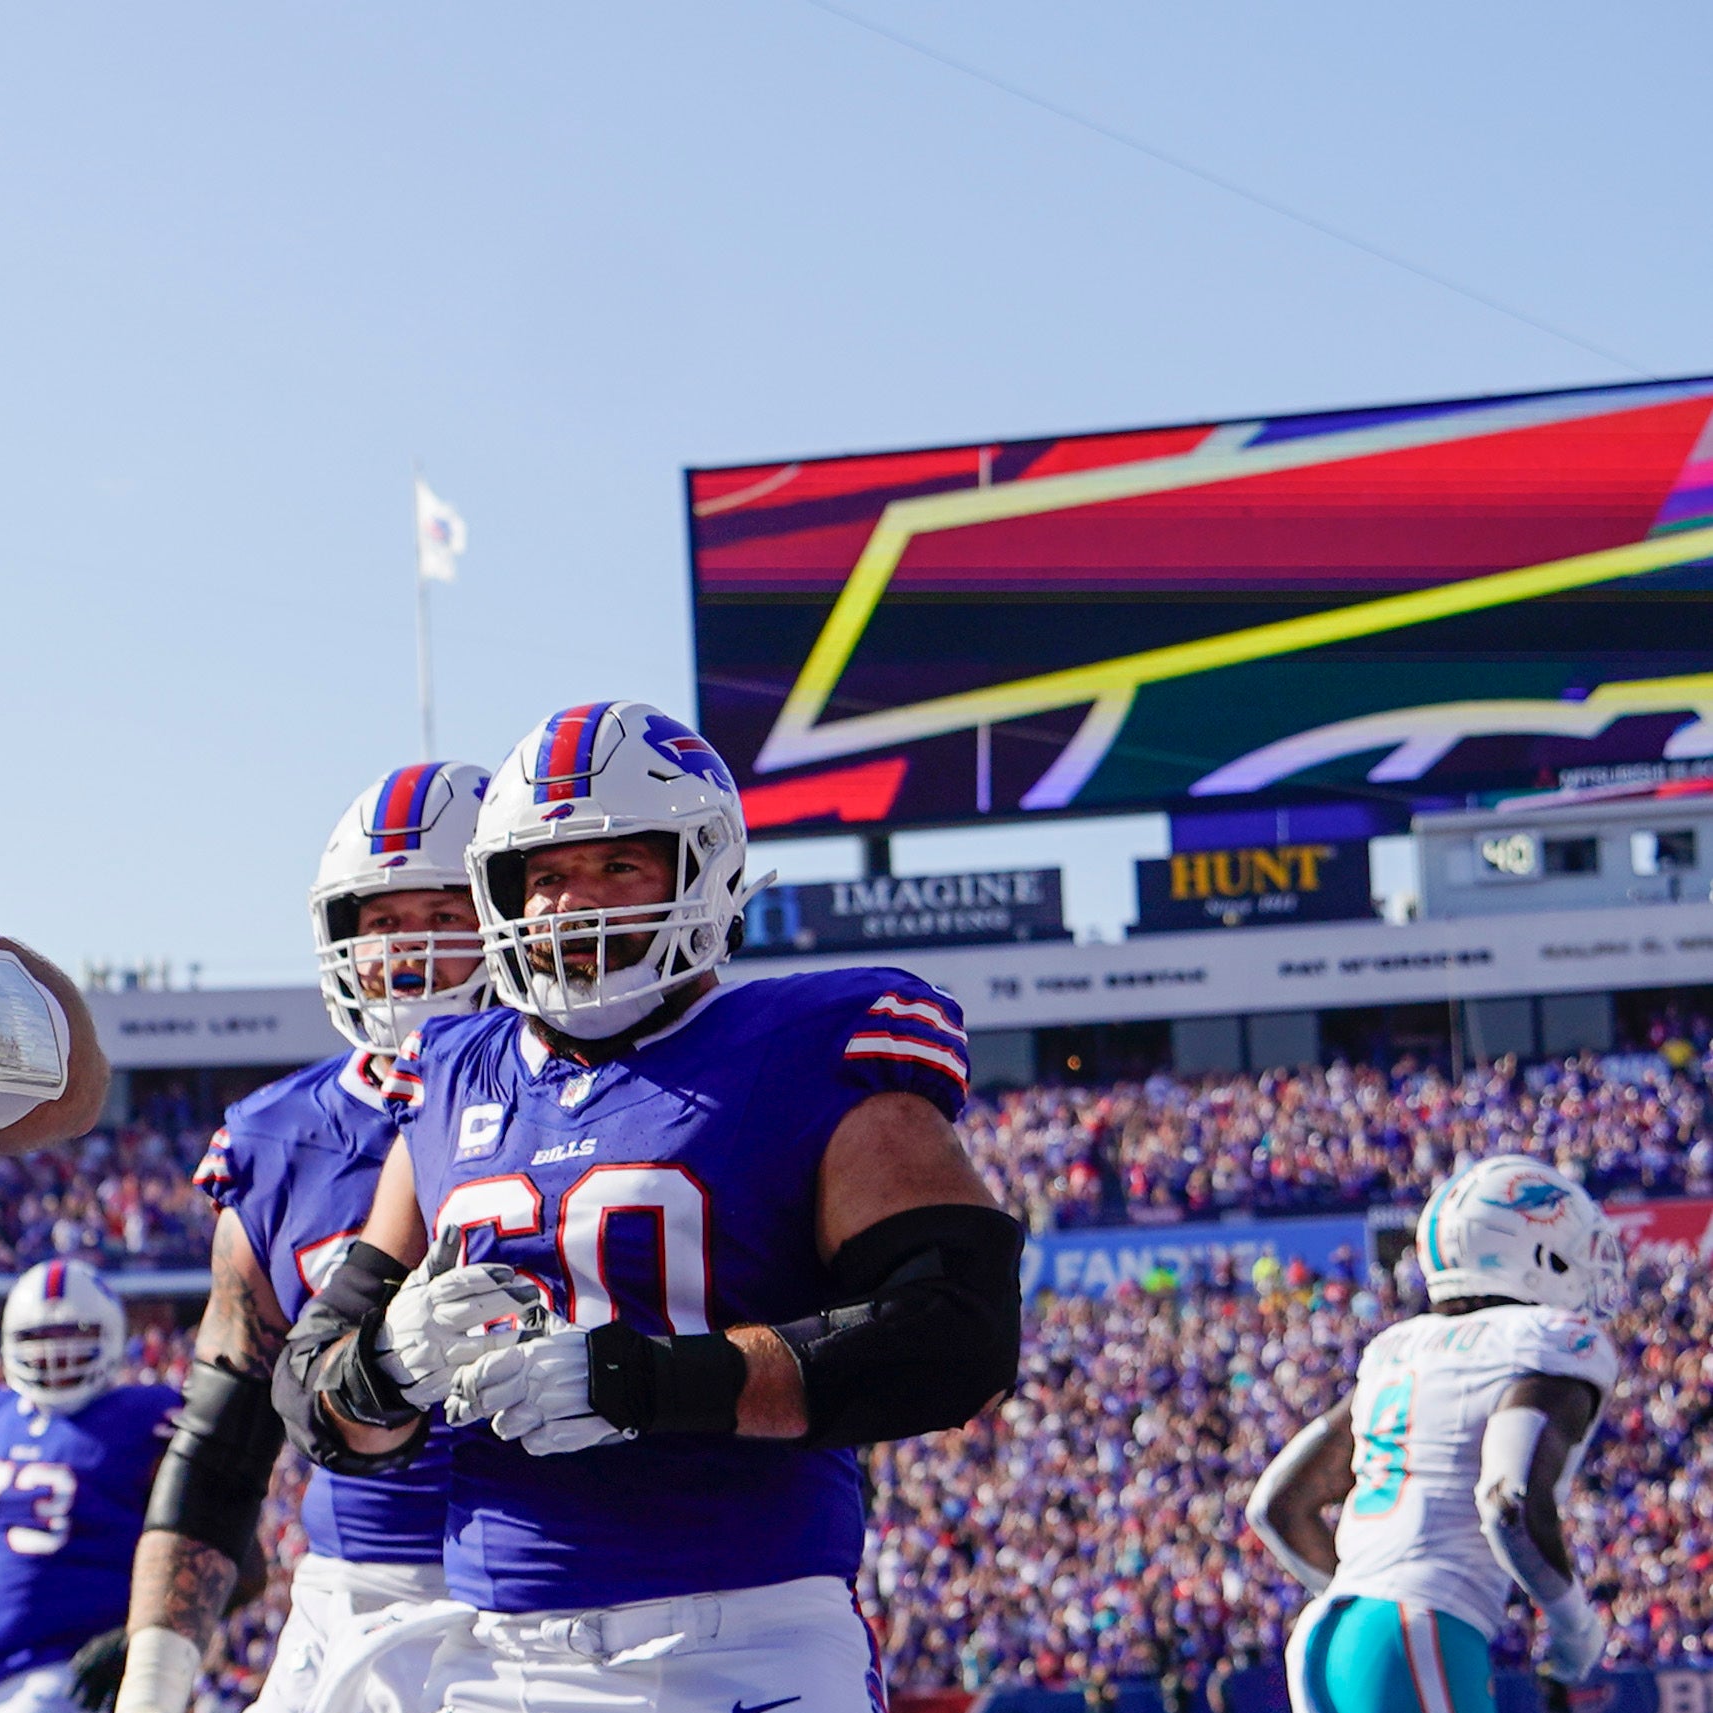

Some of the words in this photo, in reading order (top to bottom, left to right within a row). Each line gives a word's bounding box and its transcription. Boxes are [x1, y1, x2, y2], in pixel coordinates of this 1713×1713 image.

[1170, 844, 1329, 900] HUNT
[1482, 833, 1535, 875] 40
[832, 871, 1038, 916] IMAGINE
[458, 1103, 504, 1151] C
[530, 1138, 598, 1166] BILLS
